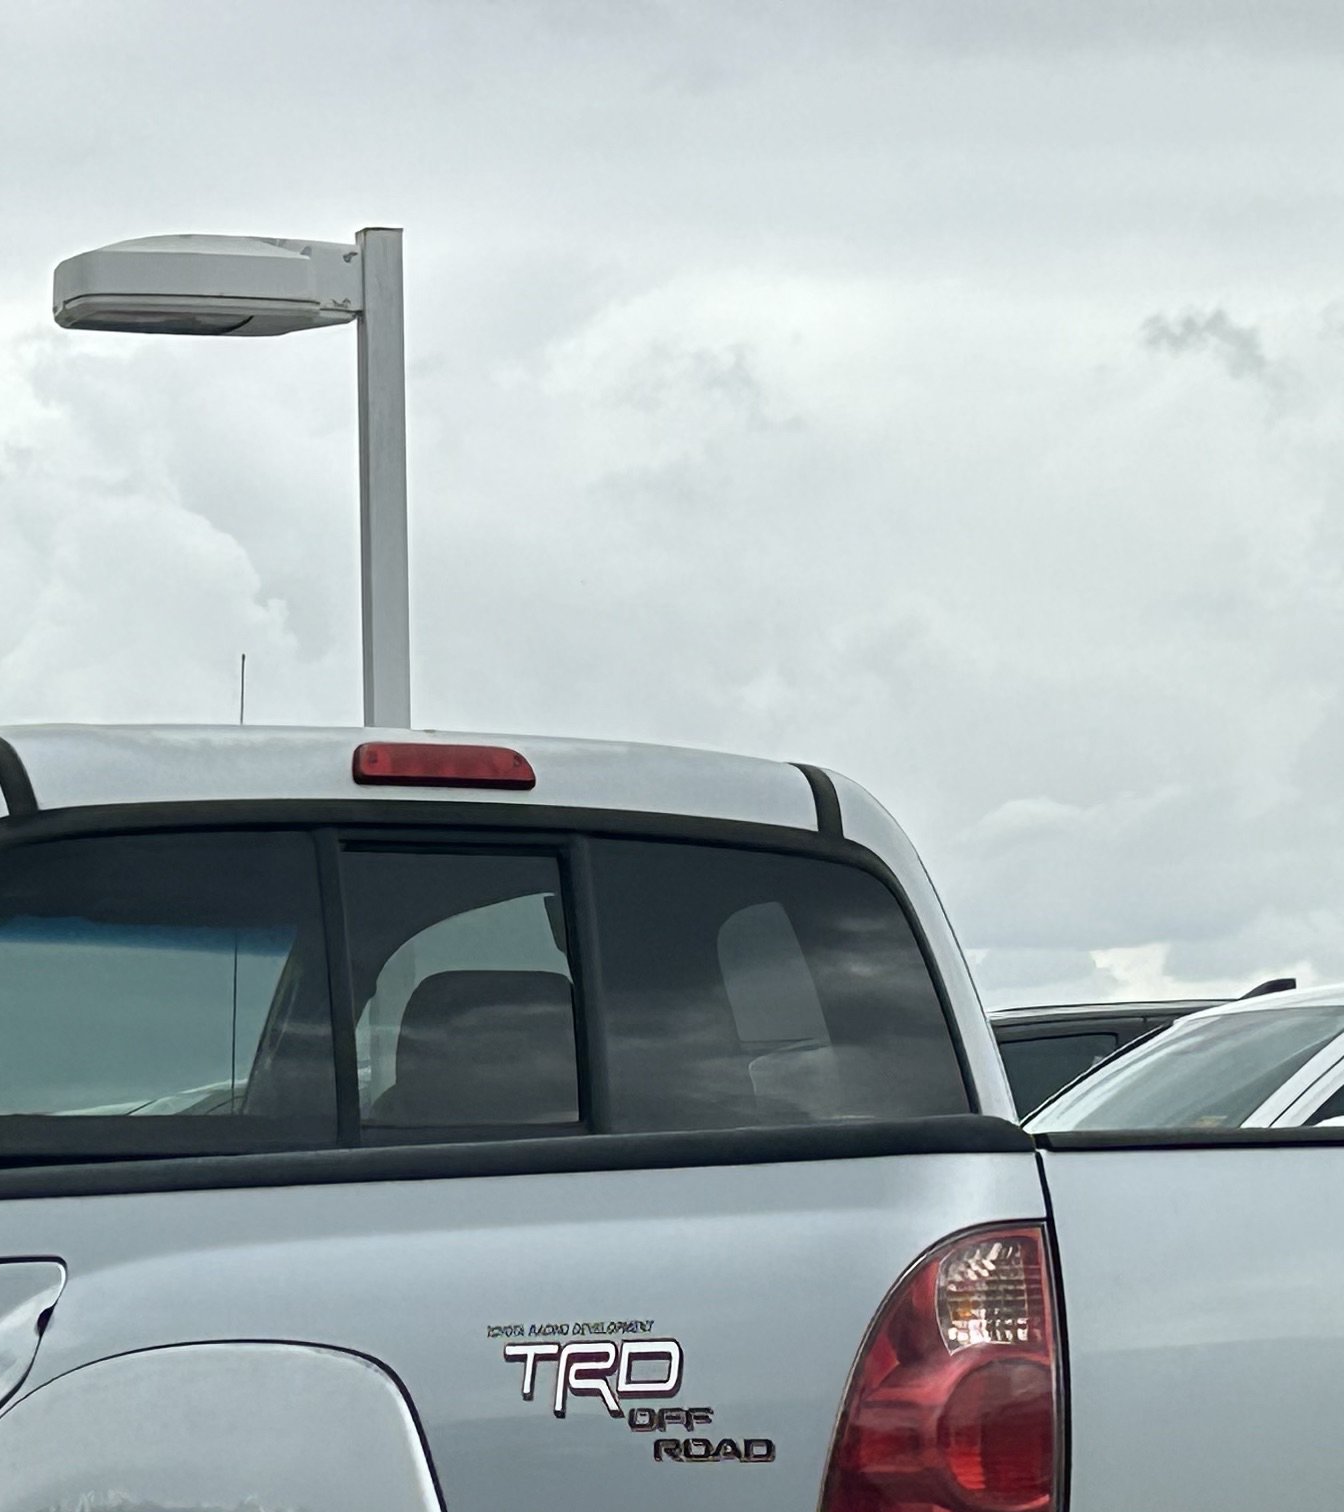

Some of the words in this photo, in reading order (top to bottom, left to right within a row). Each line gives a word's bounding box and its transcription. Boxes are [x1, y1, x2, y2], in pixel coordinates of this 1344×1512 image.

[504, 1338, 684, 1418] TRD
[628, 1406, 714, 1432] OFF
[653, 1438, 776, 1463] ROAD
